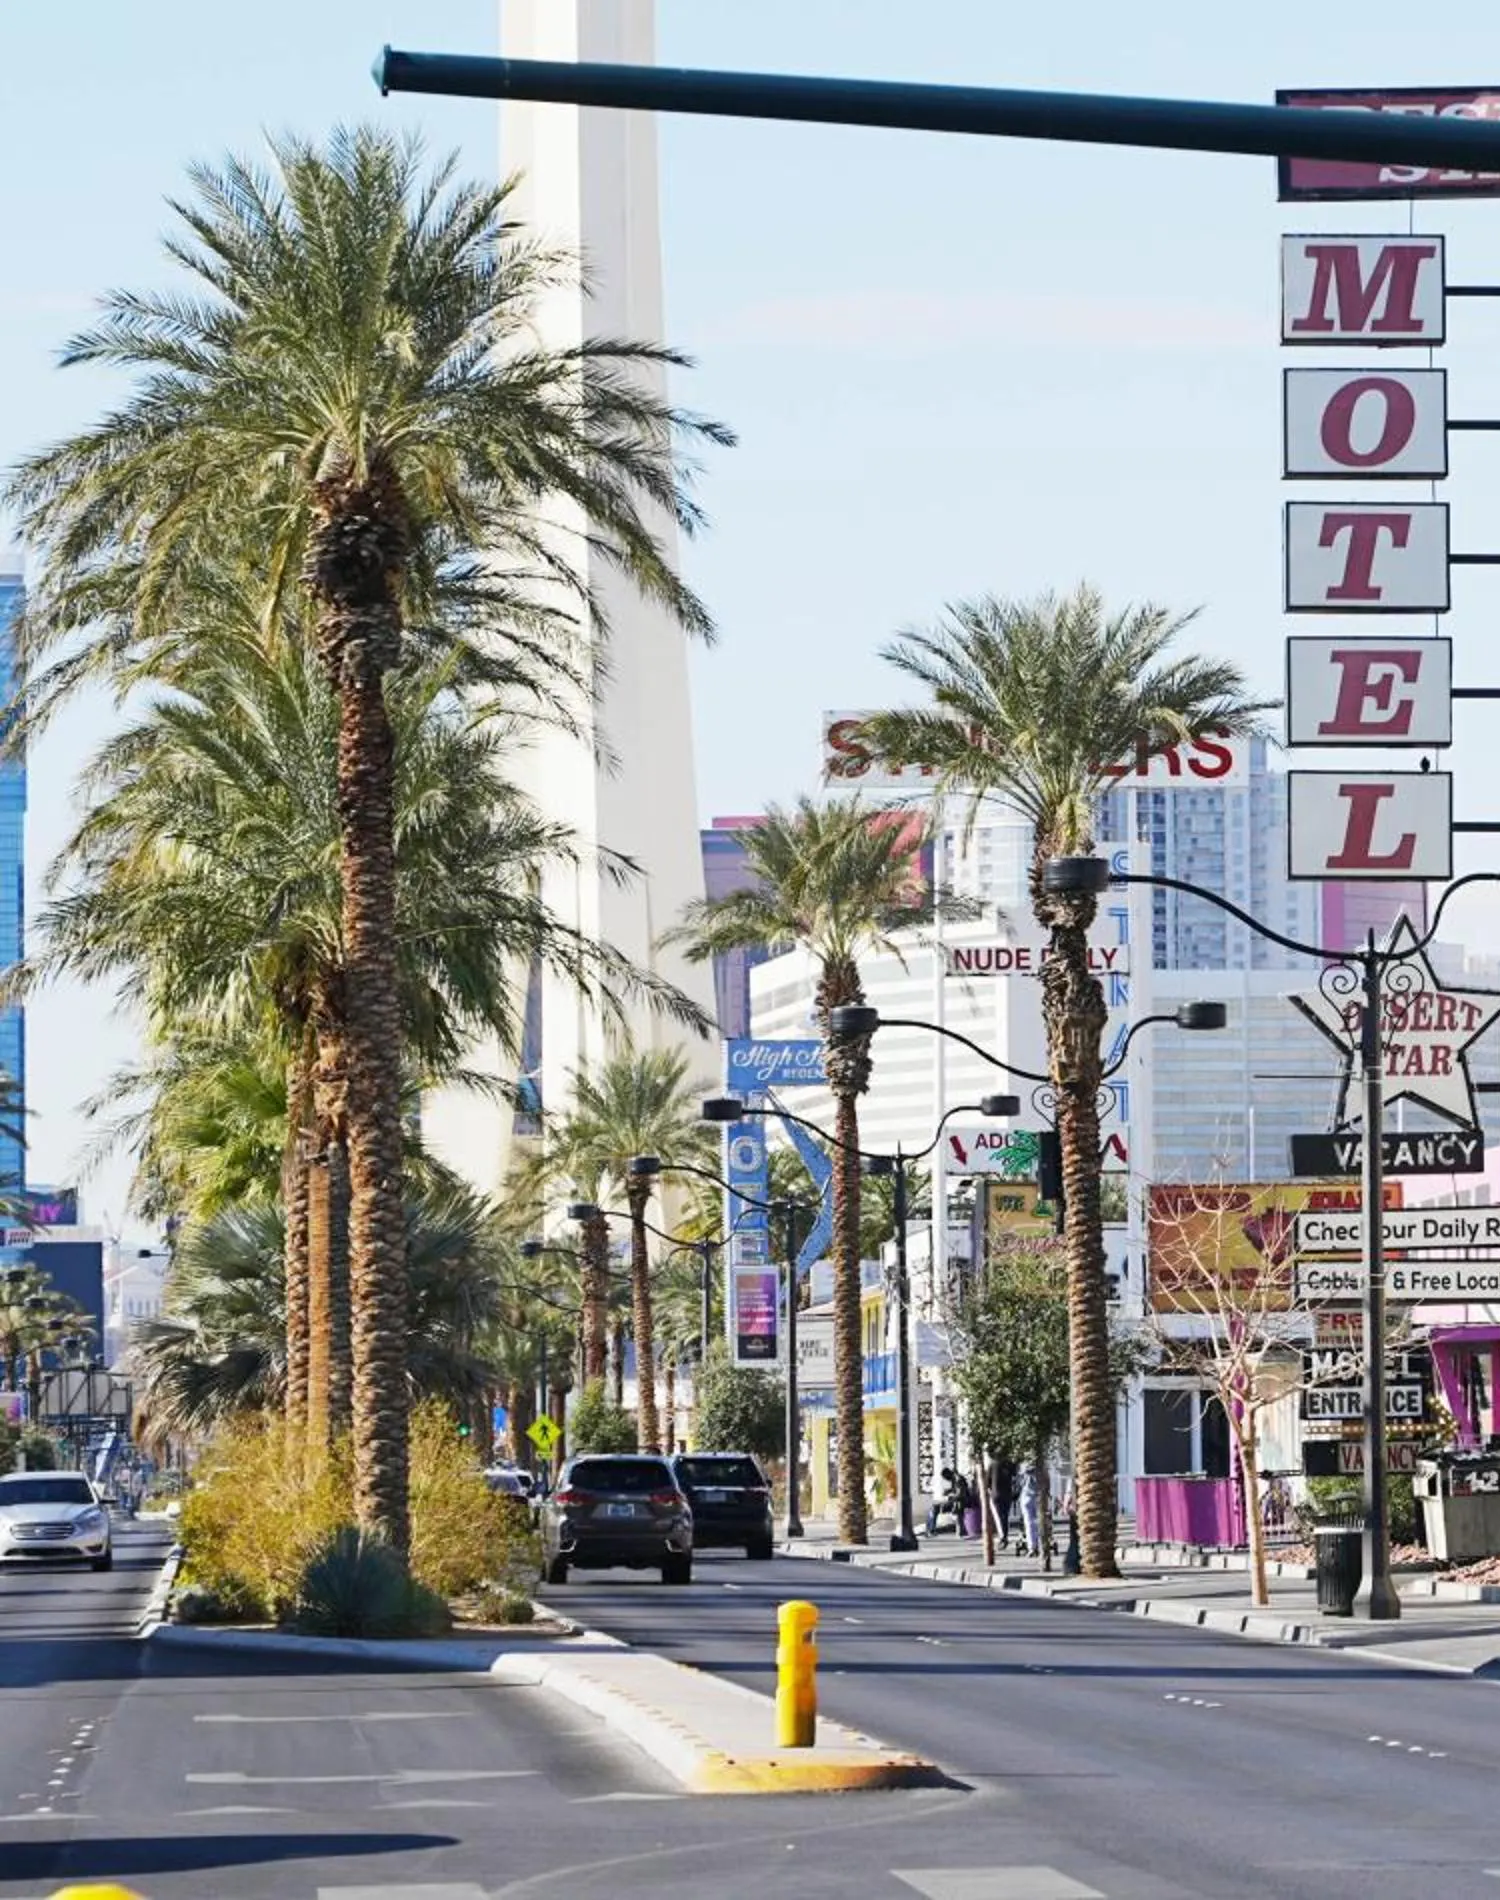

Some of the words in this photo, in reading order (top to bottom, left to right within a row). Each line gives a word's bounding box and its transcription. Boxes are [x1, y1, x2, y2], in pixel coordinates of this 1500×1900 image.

[1290, 245, 1436, 869] MOTEL
[954, 947, 1031, 970] NUDE
[733, 1045, 792, 1080] High
[1383, 1043, 1453, 1077] TAR
[1305, 1221, 1361, 1241] Chec
[1424, 1218, 1479, 1243] Daily
[1393, 1271, 1405, 1289] &
[1411, 1272, 1451, 1290] Free
[1316, 1312, 1363, 1329] FRE
[1308, 1390, 1419, 1414] ENTRCE
[1341, 1445, 1419, 1471] VANCY
